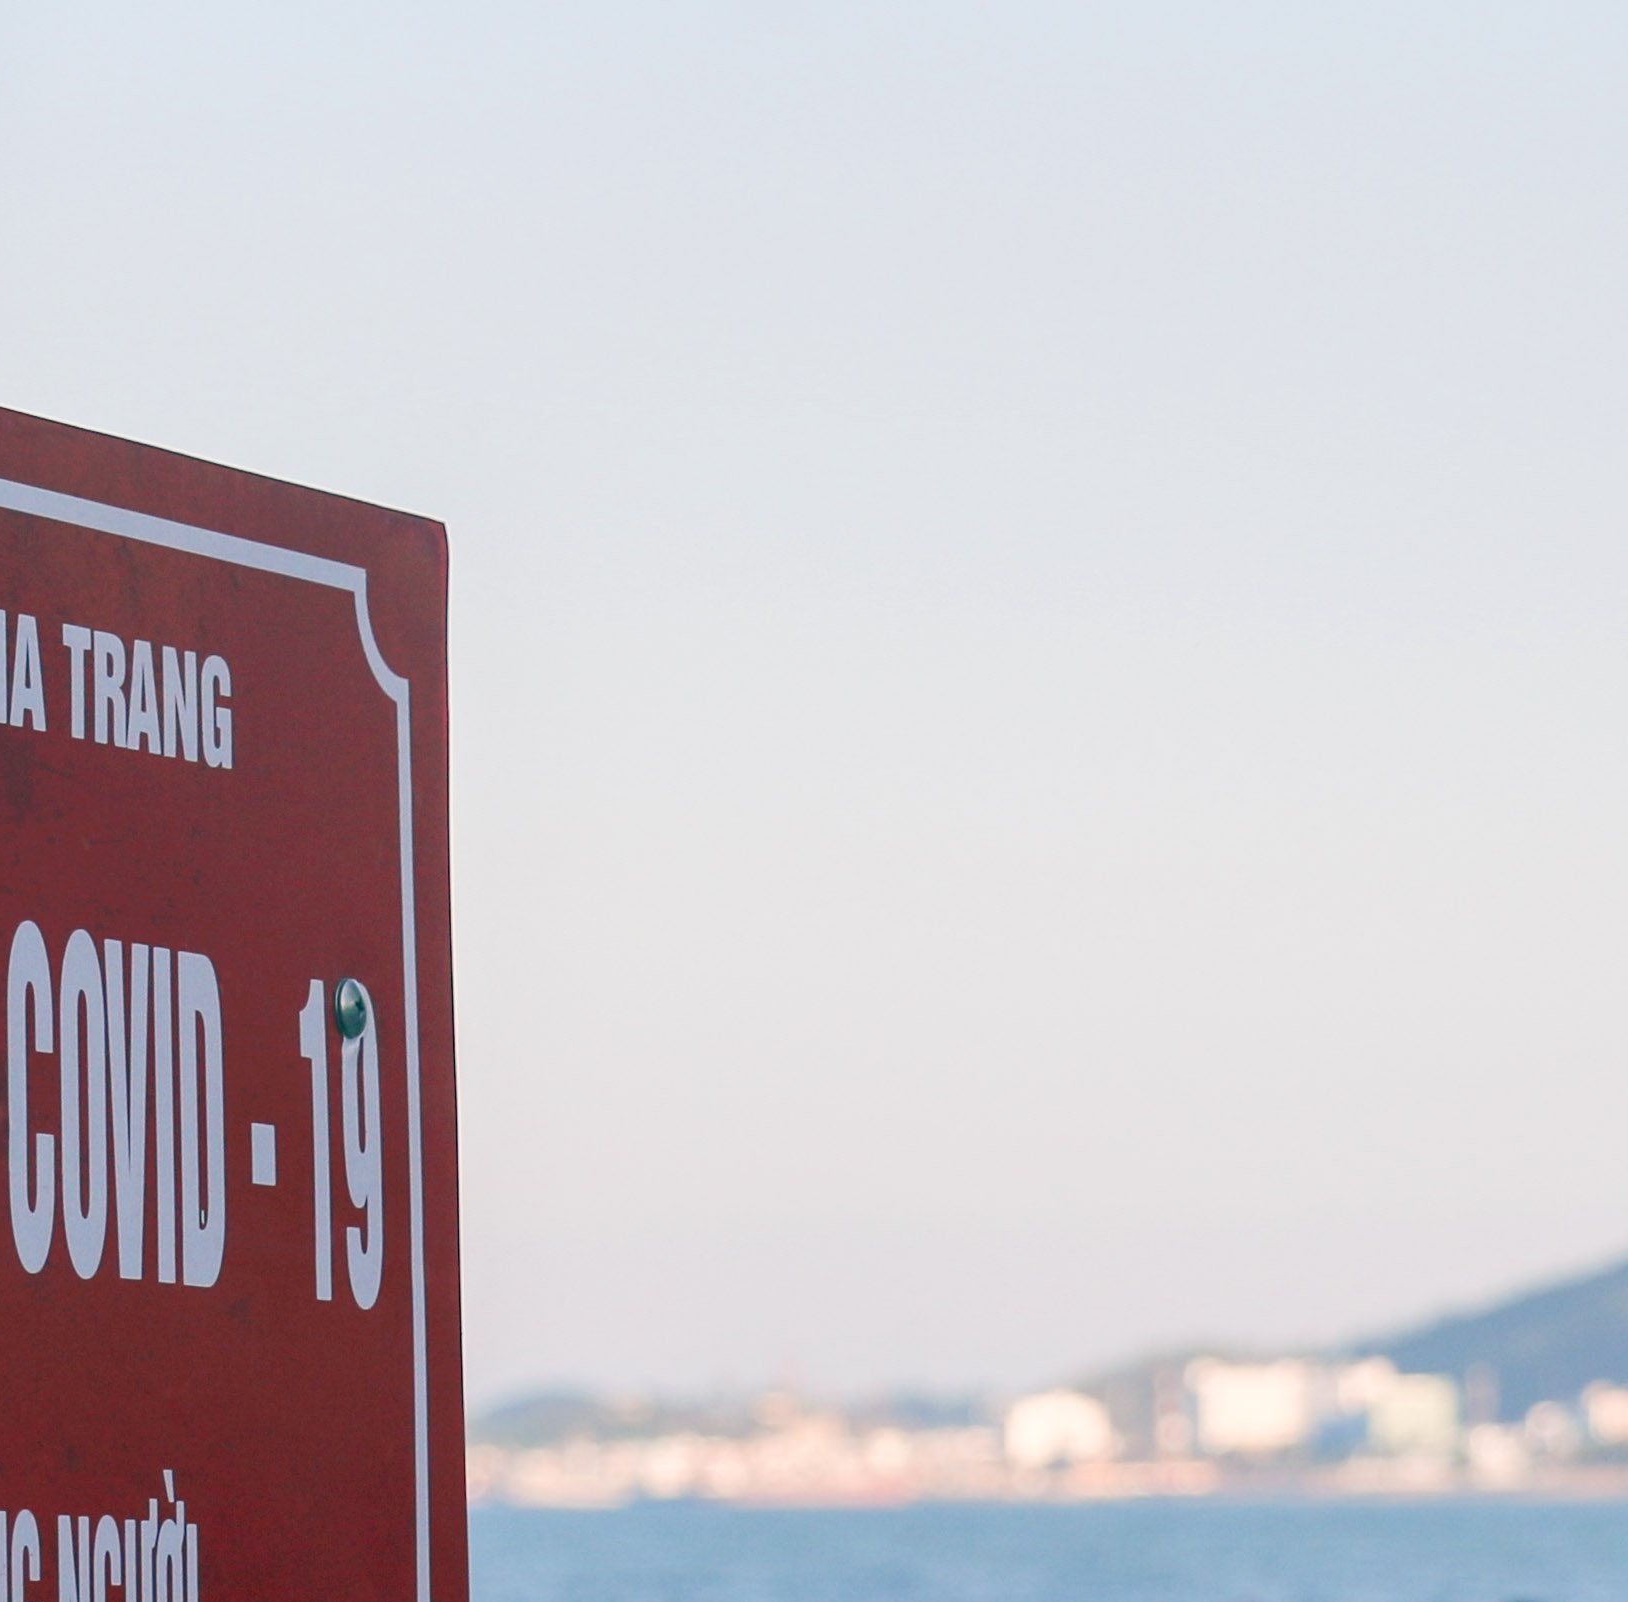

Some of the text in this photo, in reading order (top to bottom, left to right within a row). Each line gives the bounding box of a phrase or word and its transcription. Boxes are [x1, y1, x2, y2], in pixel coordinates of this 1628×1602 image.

[62, 623, 233, 770] TRANG
[6, 919, 226, 1288] COVID
[299, 977, 383, 1310] 19
